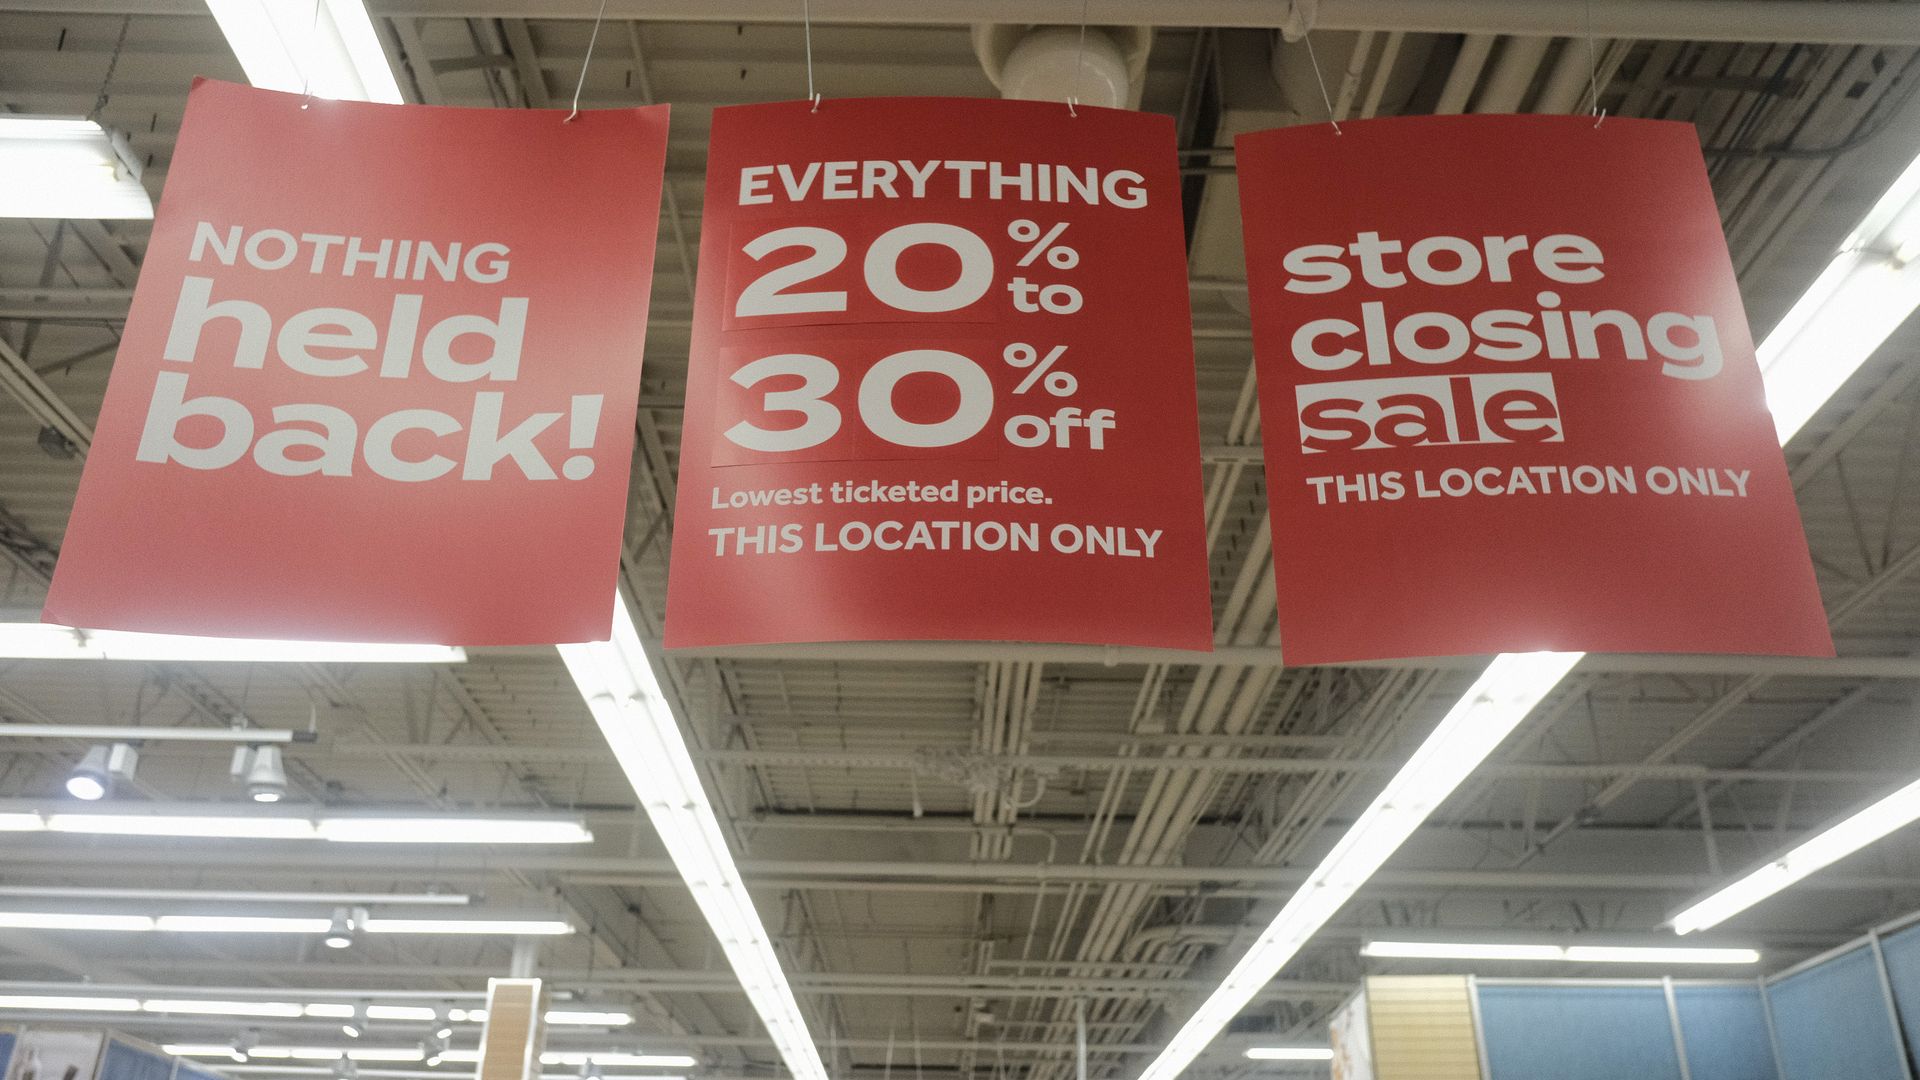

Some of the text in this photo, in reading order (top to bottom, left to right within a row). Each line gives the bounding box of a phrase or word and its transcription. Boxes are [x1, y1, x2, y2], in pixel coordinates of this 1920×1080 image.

[738, 160, 1148, 209] EVERYTHING
[189, 221, 510, 283] NOTHING
[1283, 231, 1605, 294] store
[1008, 276, 1083, 315] to
[163, 276, 529, 383] held
[1291, 291, 1723, 380] closing
[135, 371, 604, 482] back!
[1004, 408, 1117, 450] off
[1300, 376, 1558, 451] sale
[711, 480, 1053, 509] Lowest ticketed price.
[1306, 466, 1750, 504] THIS LOCATION ONLY
[708, 521, 1163, 558] THIS LOCATION ONLY
